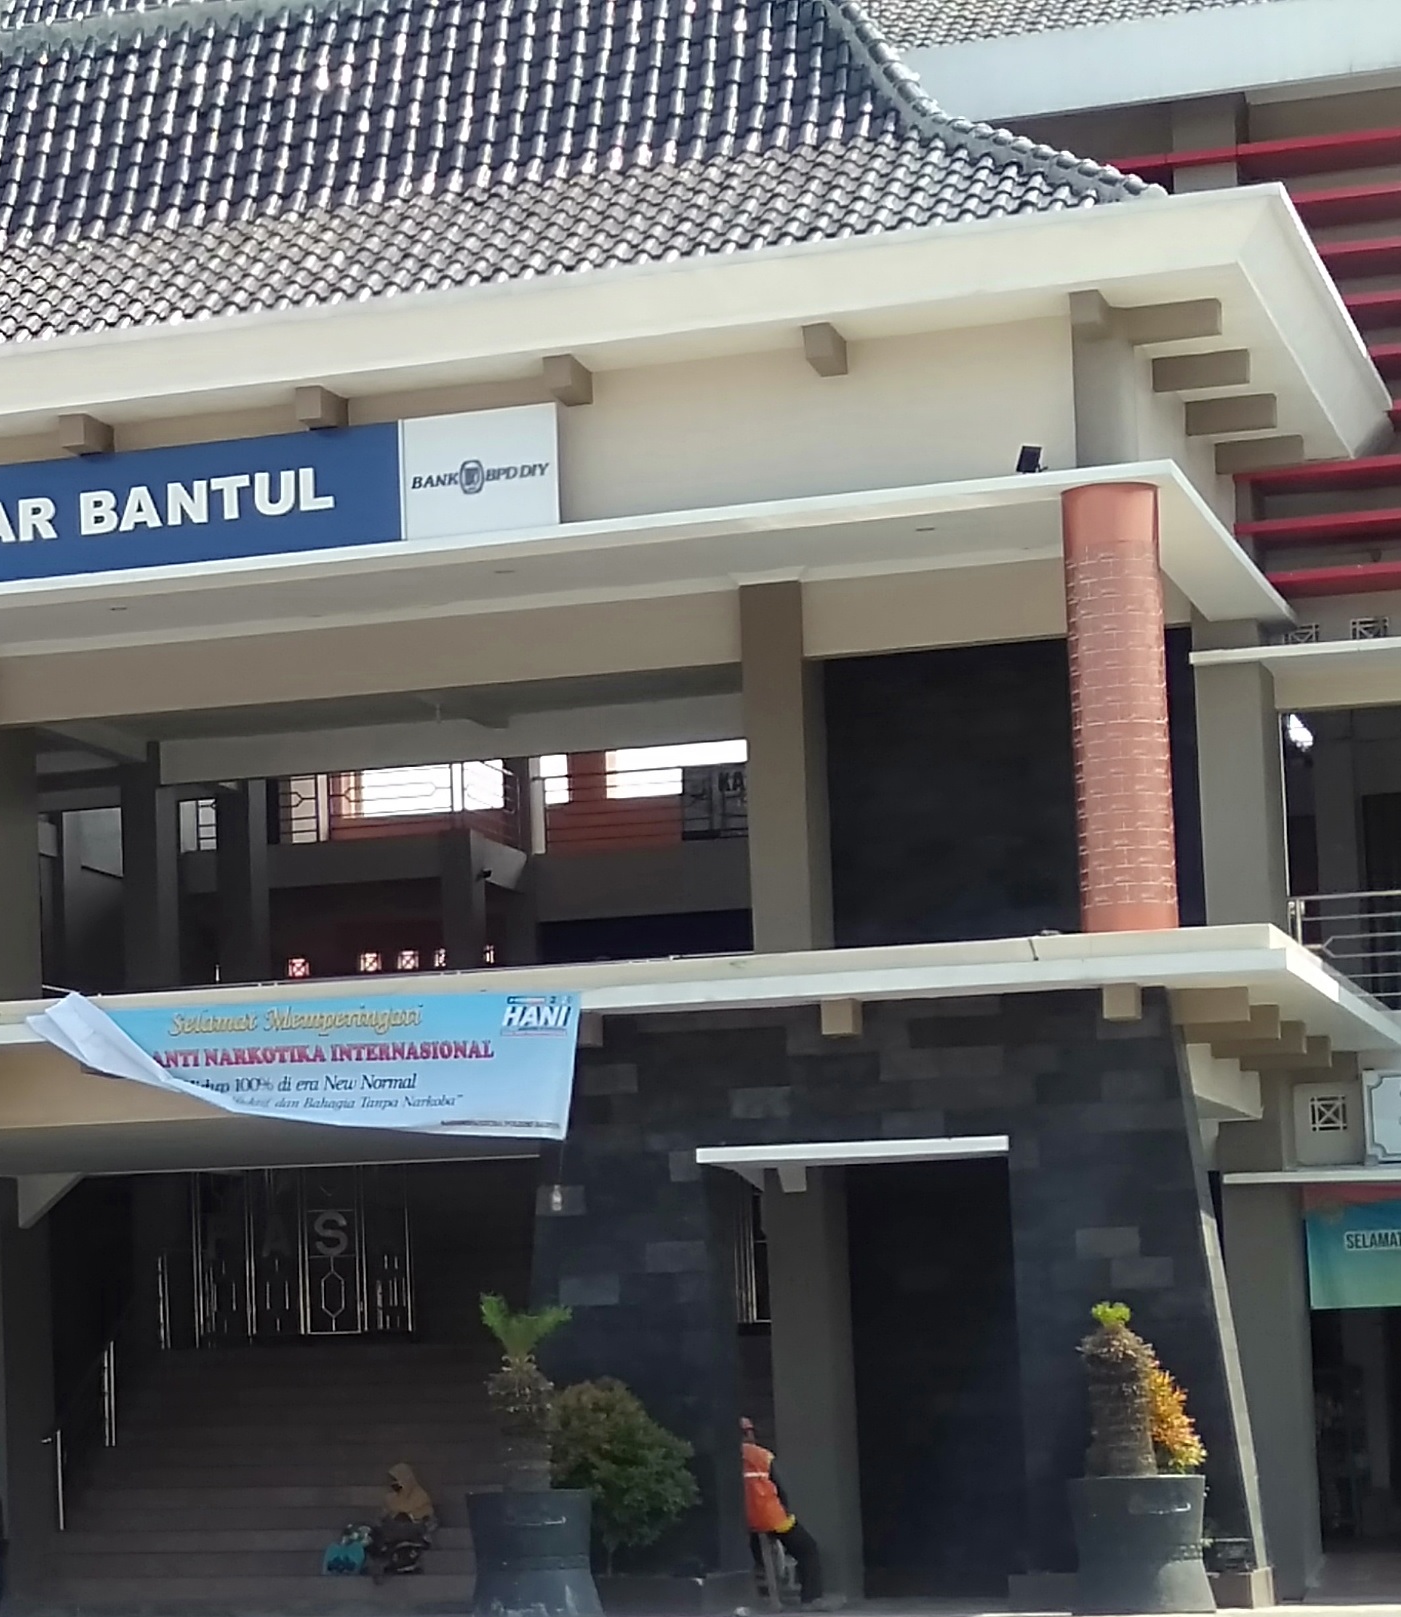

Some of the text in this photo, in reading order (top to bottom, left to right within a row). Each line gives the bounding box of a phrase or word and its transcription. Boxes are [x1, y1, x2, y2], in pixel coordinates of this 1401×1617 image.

[411, 472, 460, 490] BANK
[79, 467, 335, 536] BANTUL
[168, 1010, 258, 1037] Selamat
[502, 1005, 571, 1027] HANI
[153, 1040, 495, 1069] ANTI NARKOTIKA INTERNASIONAL
[235, 1077, 274, 1093] 100%
[277, 1075, 292, 1092] di
[296, 1080, 319, 1092] era
[324, 1075, 357, 1091] New
[360, 1073, 418, 1091] Normal
